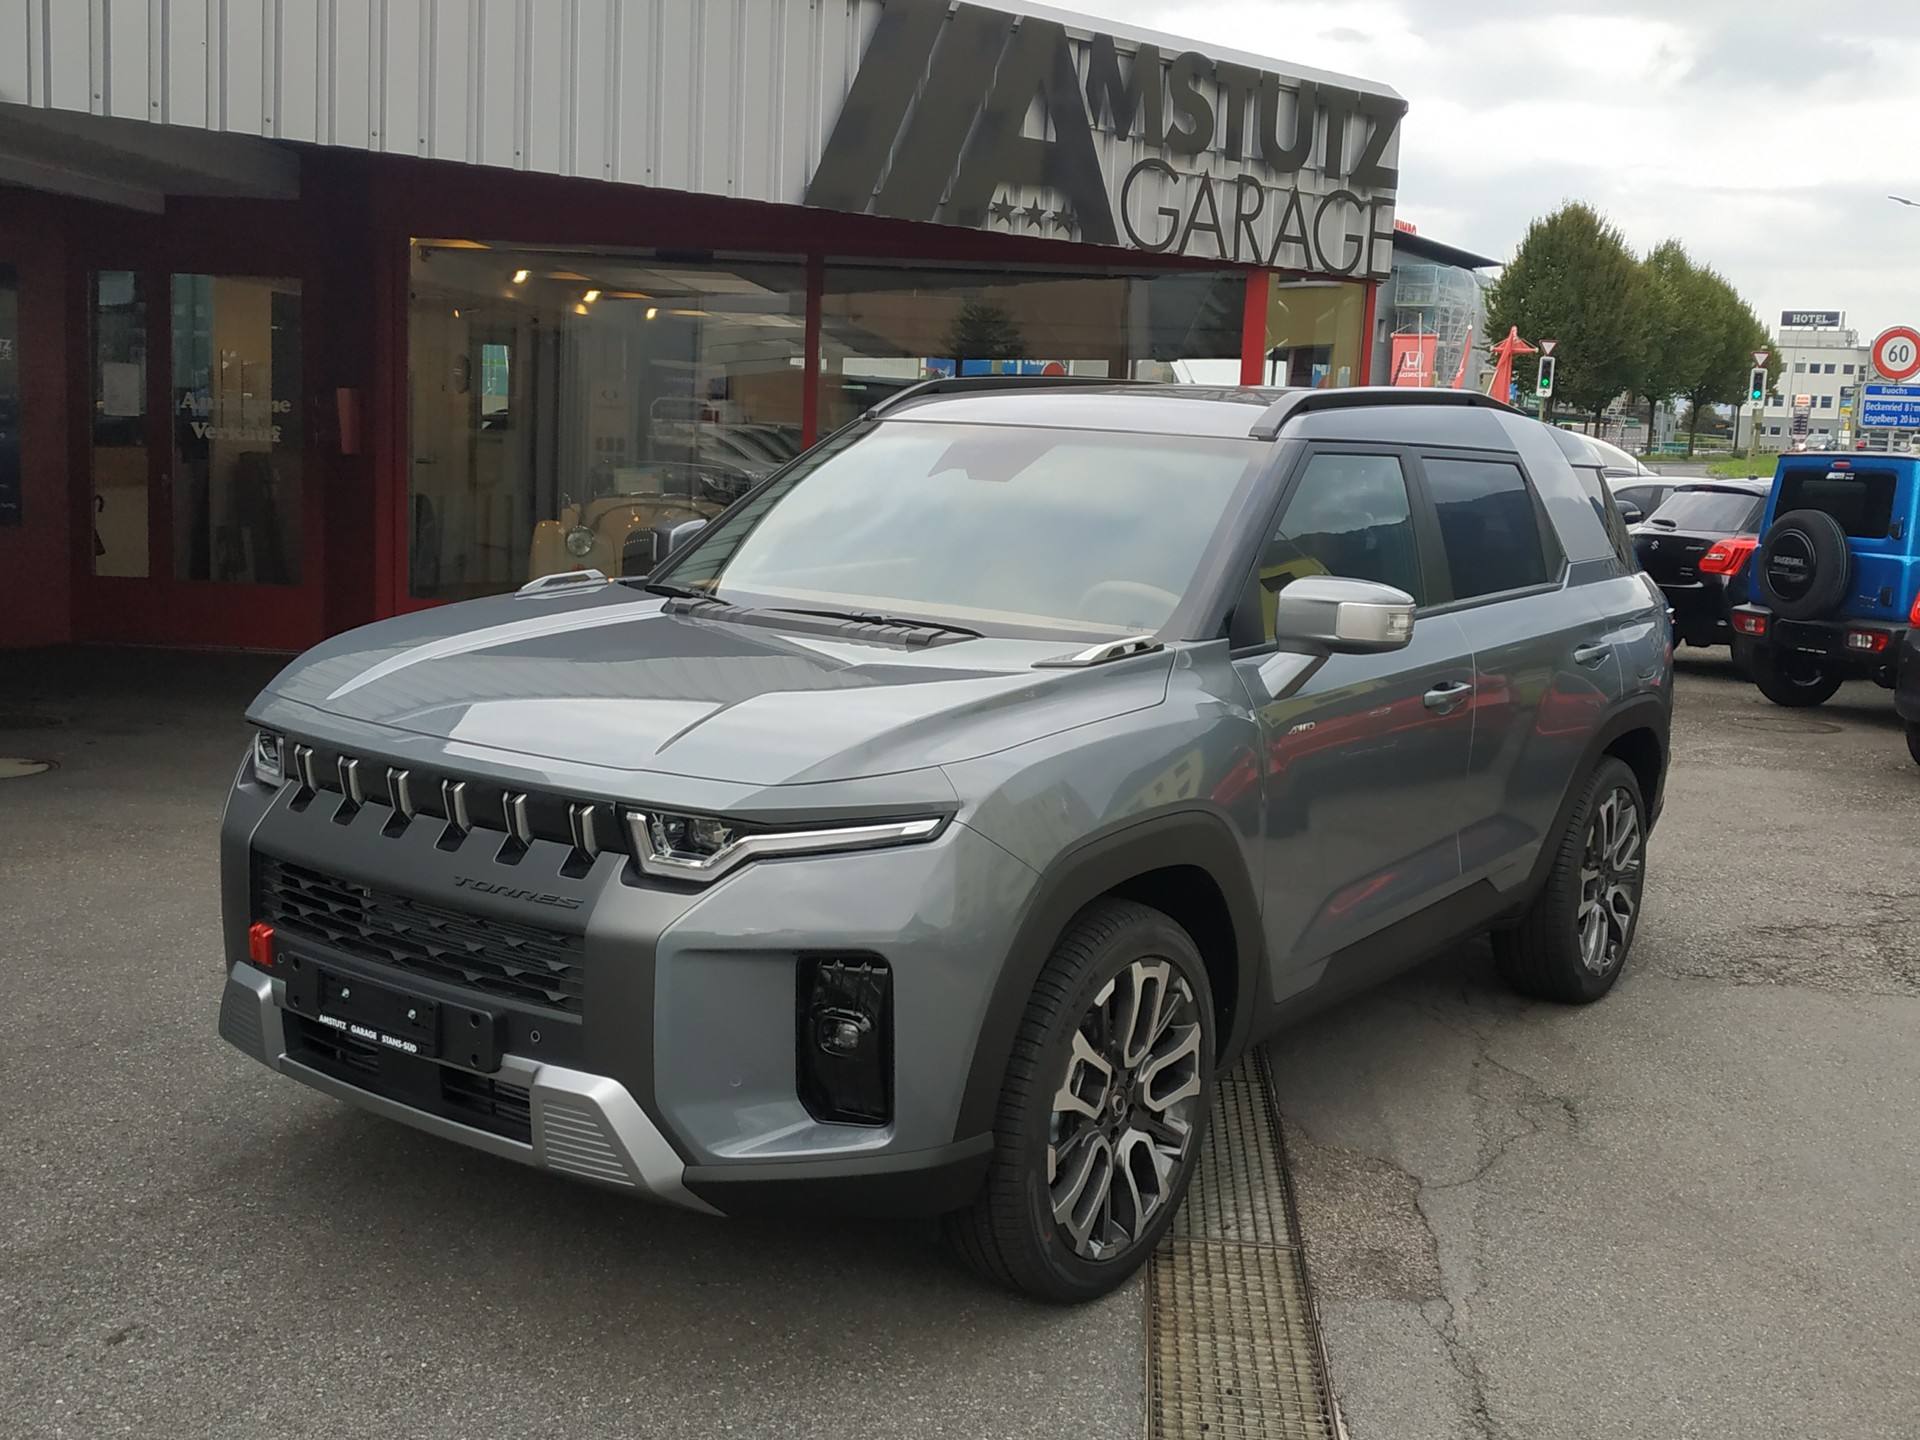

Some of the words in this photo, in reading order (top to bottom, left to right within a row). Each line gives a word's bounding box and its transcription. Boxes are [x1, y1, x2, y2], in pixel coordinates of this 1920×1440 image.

[934, 15, 1405, 246] AMSTUTZ
[1121, 157, 1397, 279] GARAGE
[1395, 218, 1417, 236] UMBO
[1791, 313, 1829, 325] HOTEL
[1888, 344, 1909, 363] 60
[1881, 386, 1908, 395] Buochs
[1865, 402, 1903, 412] Beckenried
[1904, 403, 1910, 412] 8
[1864, 413, 1898, 425] Engelberg
[1899, 414, 1909, 423] 20
[1773, 555, 1804, 566] SUZUKI
[454, 875, 585, 909] TORRES
[318, 1014, 347, 1030] AMSTUTZ
[350, 1024, 377, 1040] GARAGE
[381, 1034, 418, 1053] STANS-SÜD
